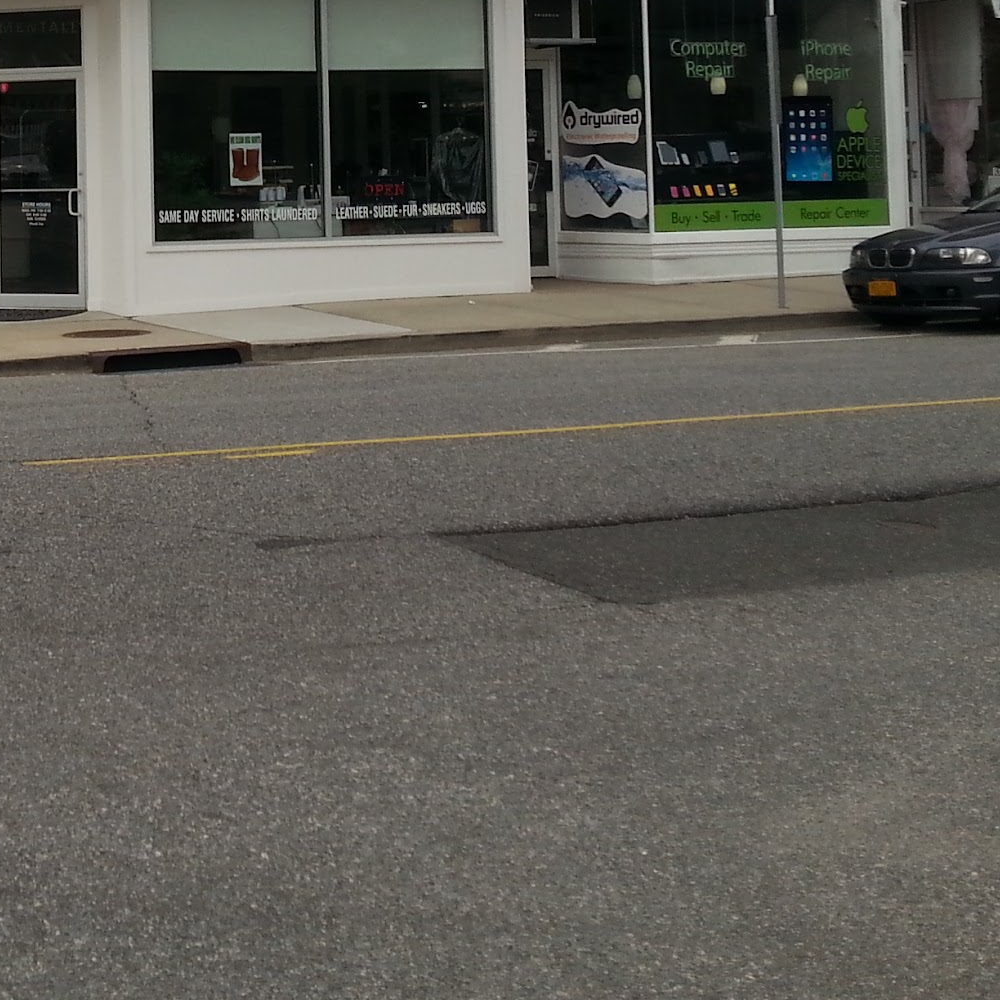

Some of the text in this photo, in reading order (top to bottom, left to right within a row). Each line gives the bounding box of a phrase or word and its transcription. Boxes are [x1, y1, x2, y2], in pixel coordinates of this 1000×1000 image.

[670, 39, 746, 58] Computer
[801, 39, 851, 56] iPhone
[685, 60, 735, 81] Repair
[805, 64, 851, 84] Repair
[580, 110, 639, 128] drywired
[837, 136, 881, 152] APPLE
[836, 154, 881, 169] DEVICE
[364, 184, 405, 196] OPEN
[158, 207, 318, 223] SAME DAY SERVICE SHIRTS LAUNDERED
[335, 201, 486, 219] LEATHER SUEDE FUR SNEAKERS UGGS
[671, 210, 761, 227] Buy Sell Trade
[801, 206, 870, 222] Repair Center
